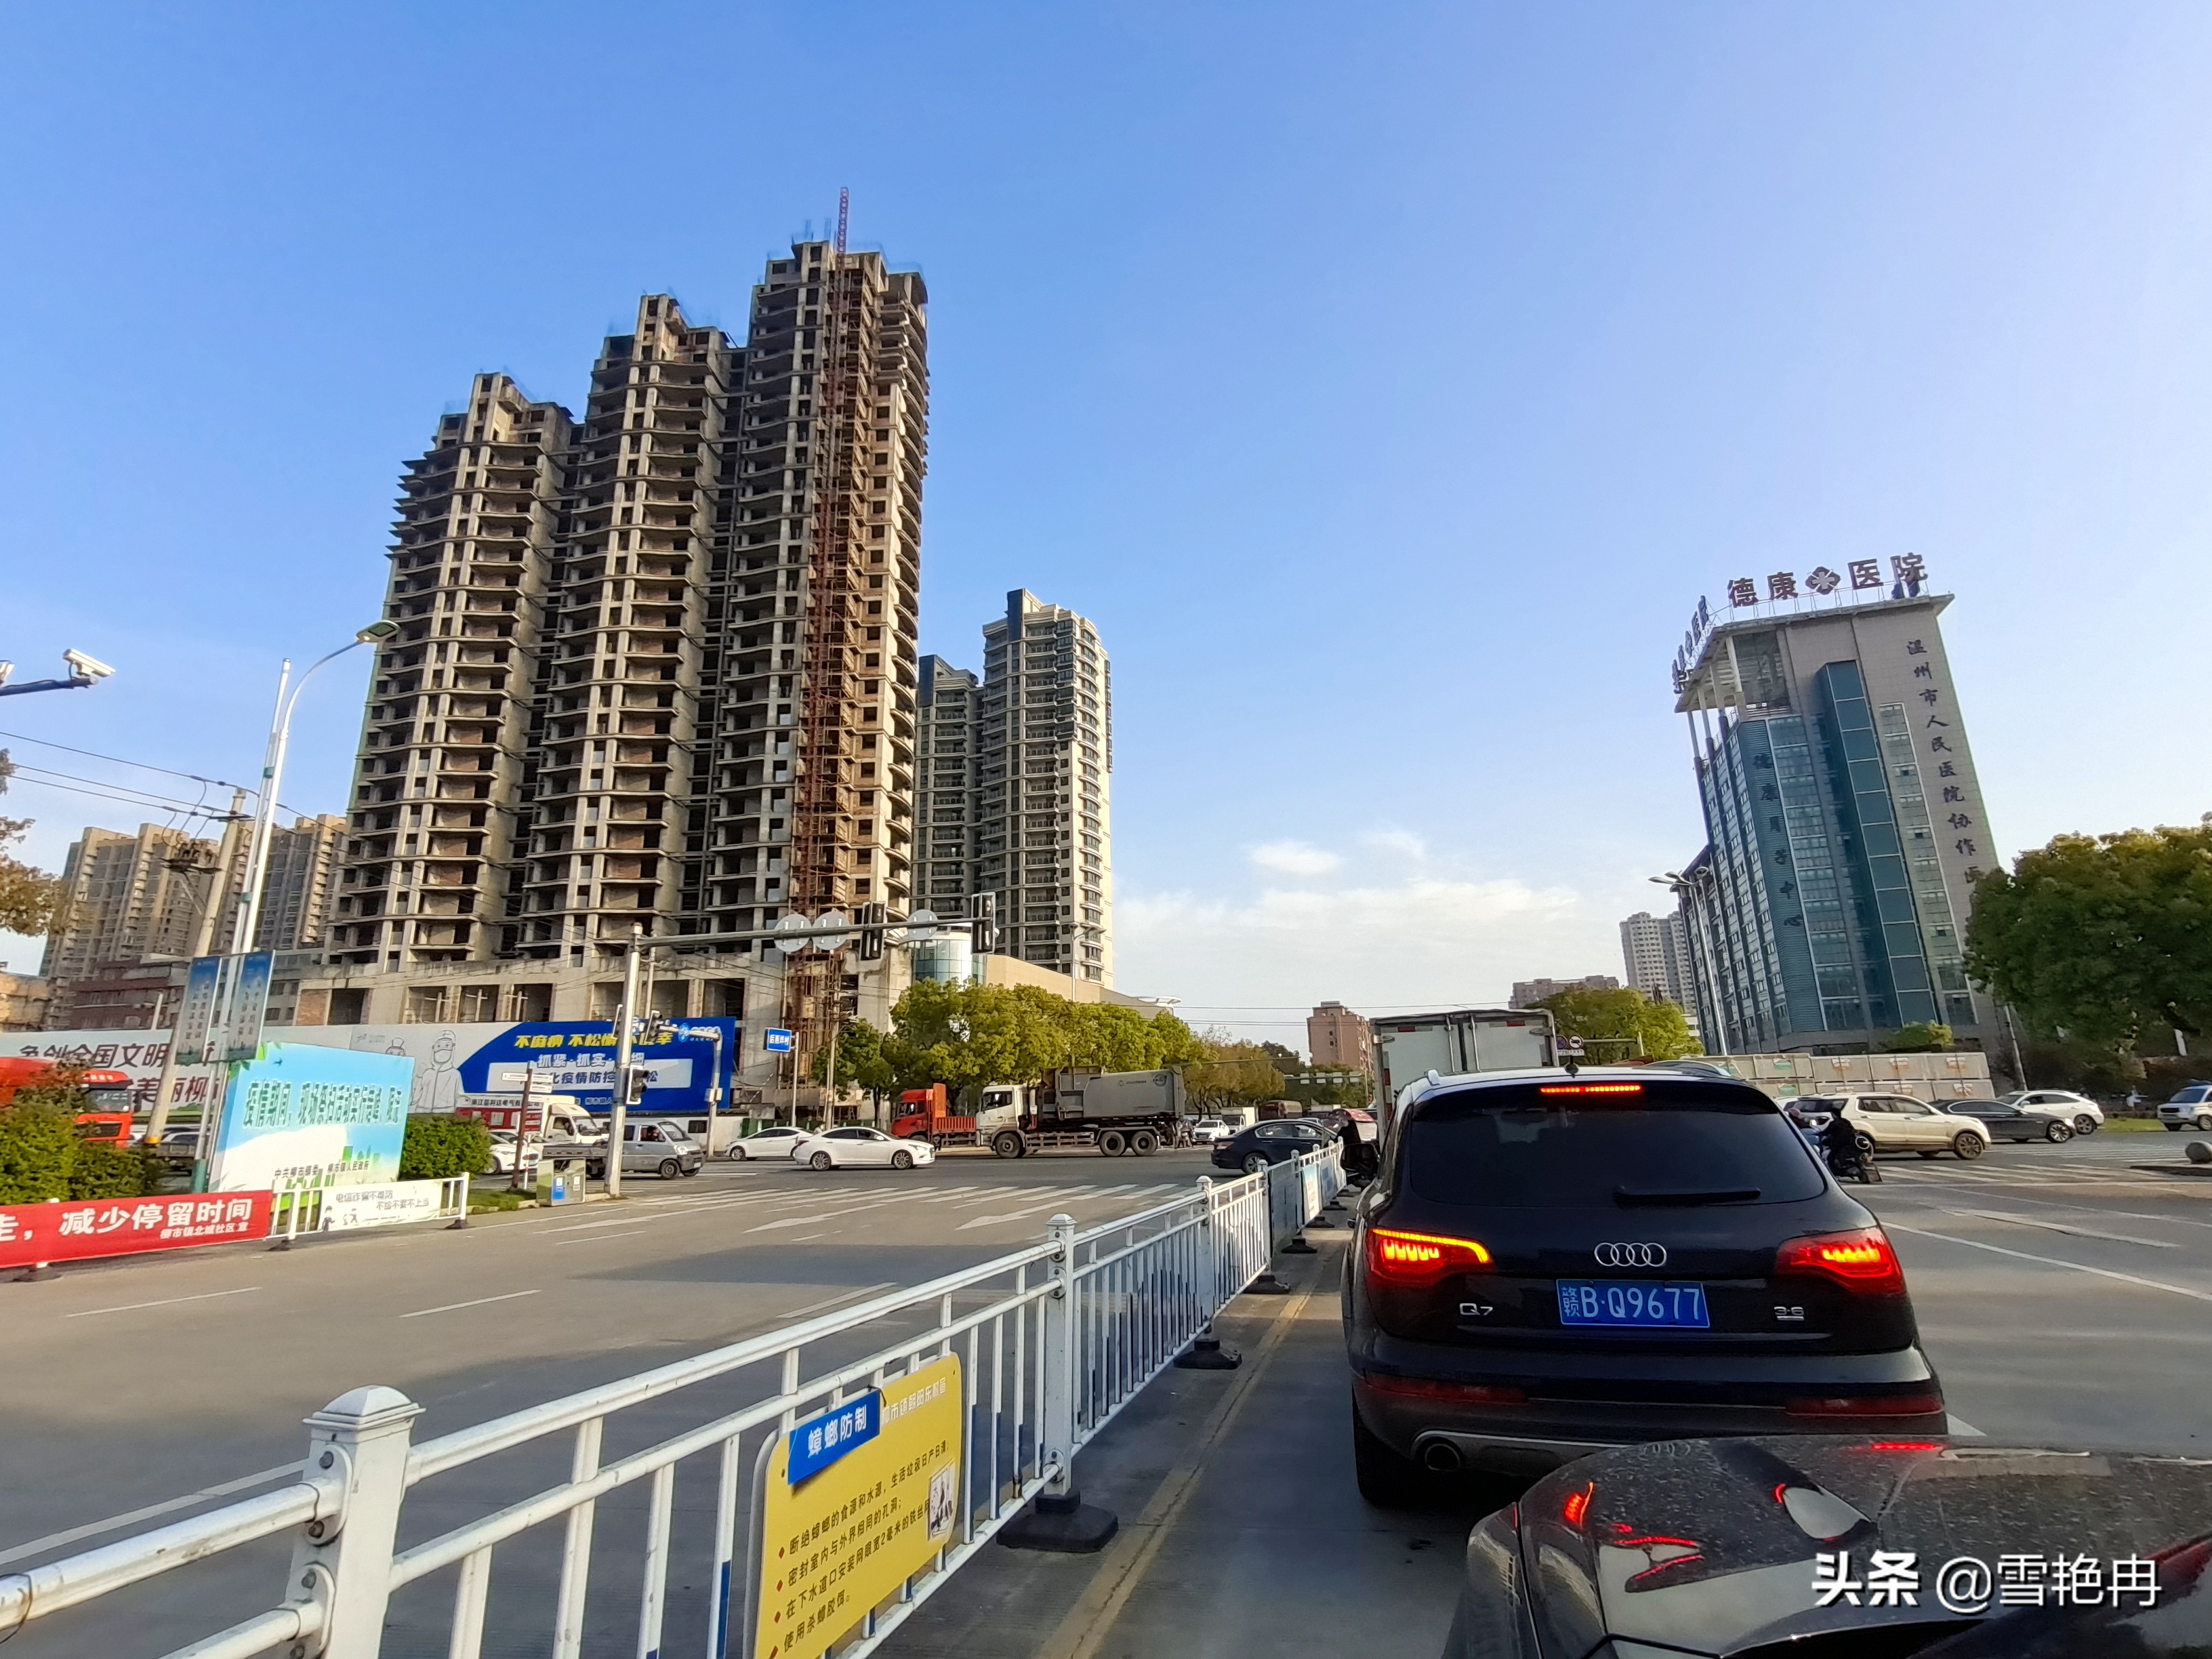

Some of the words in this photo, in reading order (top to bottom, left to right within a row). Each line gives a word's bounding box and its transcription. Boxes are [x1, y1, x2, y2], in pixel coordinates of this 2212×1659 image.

[19, 1041, 215, 1068] 争创全国文明
[1459, 1303, 1494, 1315] Q7
[807, 1404, 867, 1458] 蟑螂防制
